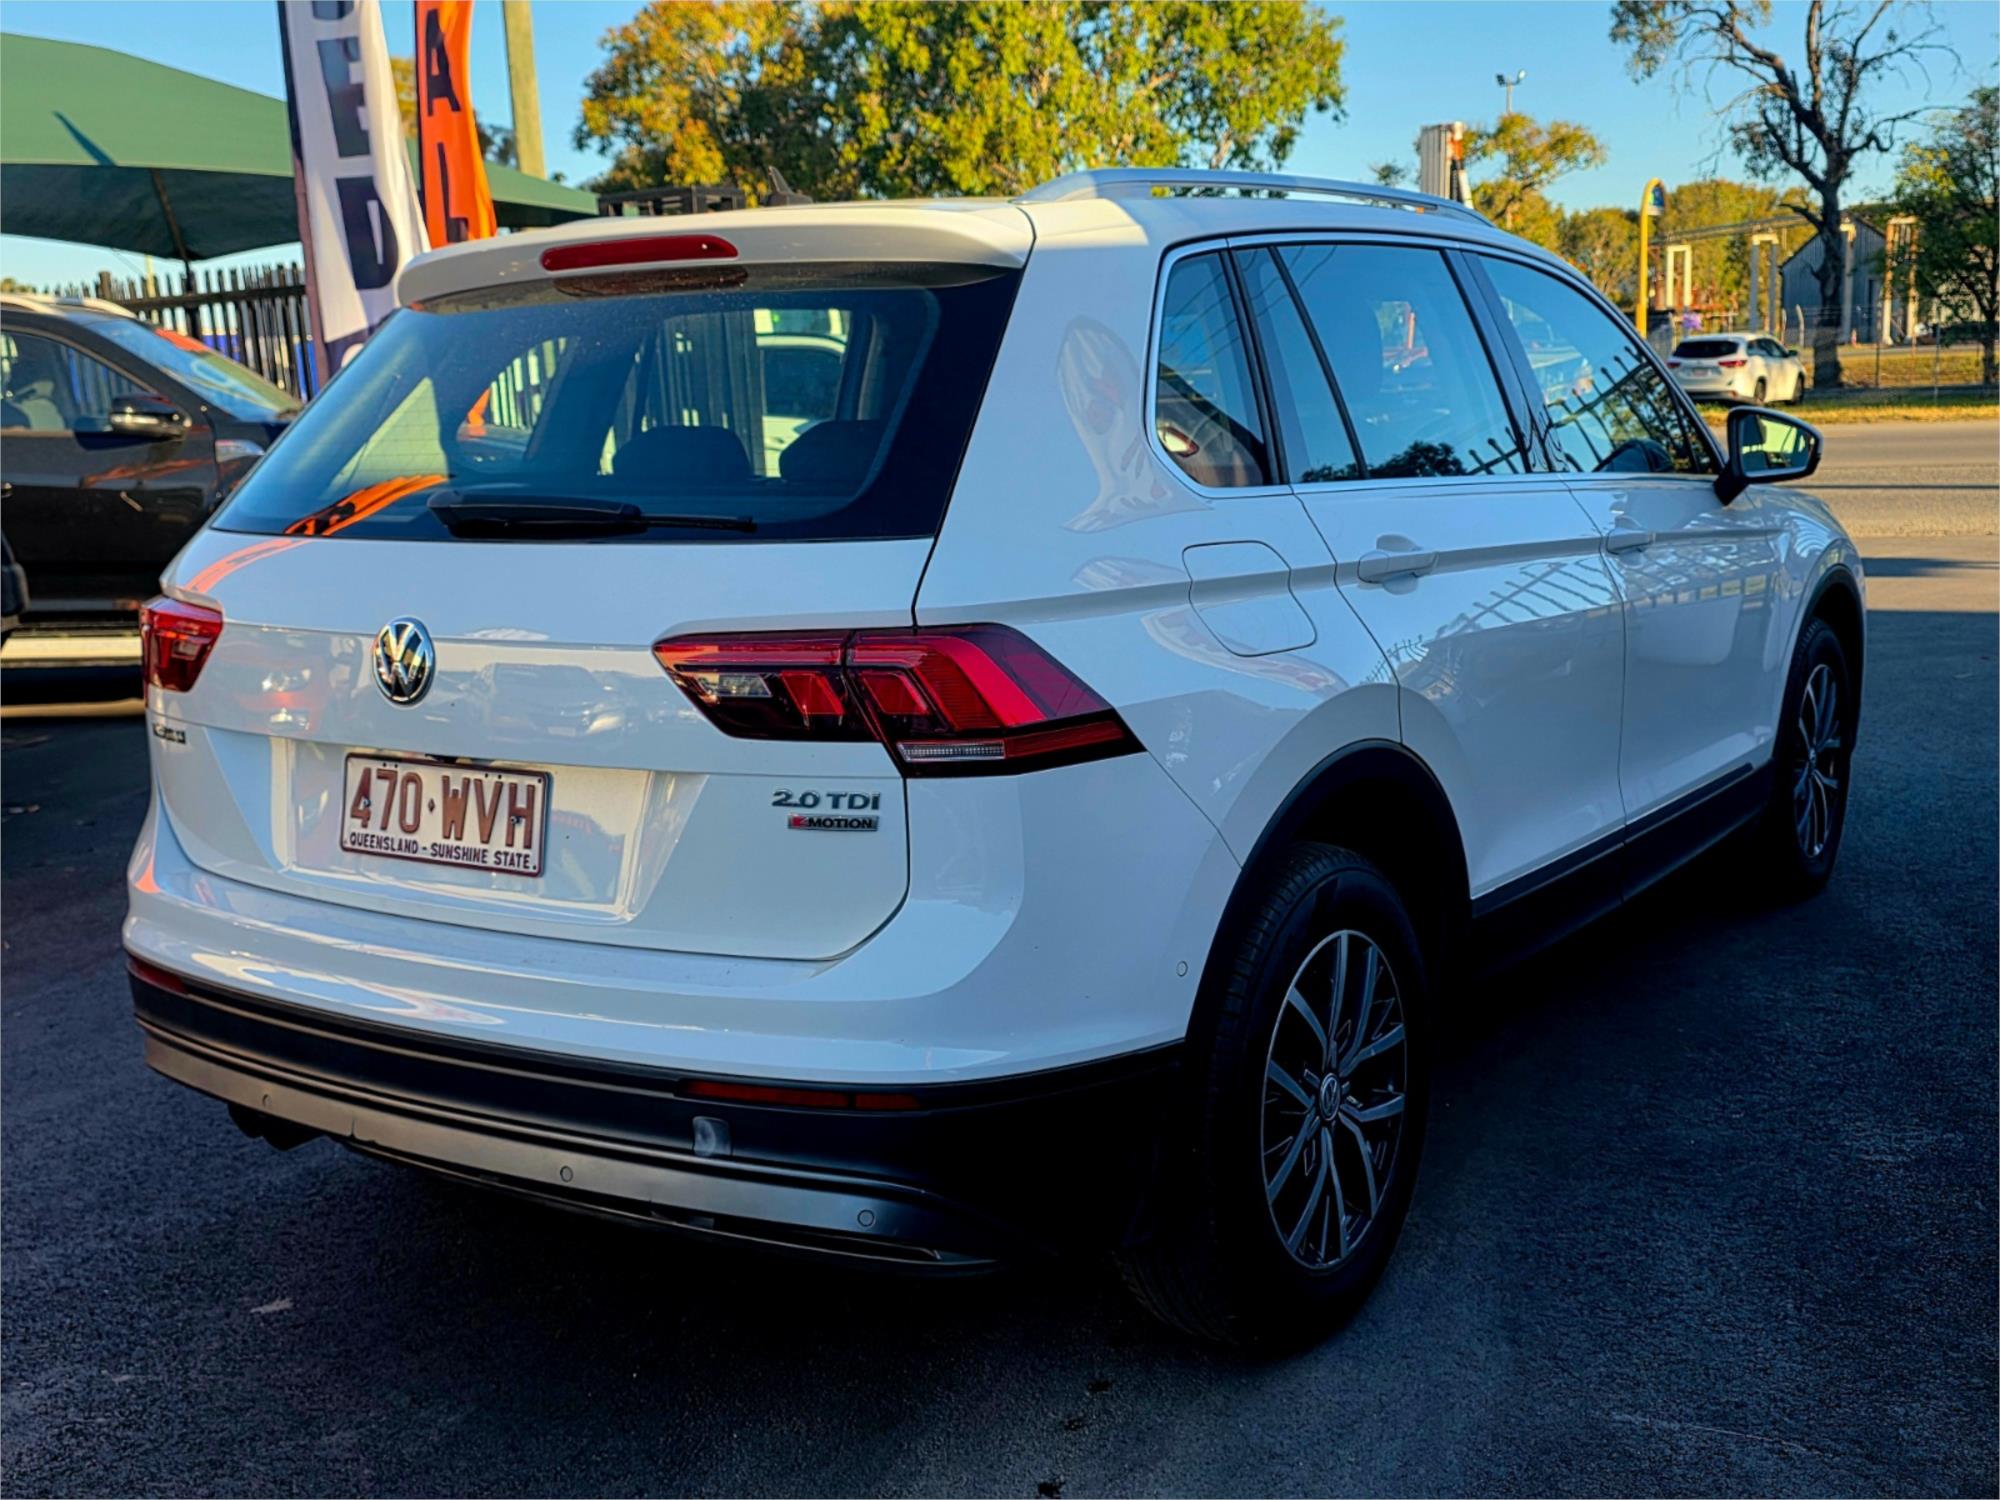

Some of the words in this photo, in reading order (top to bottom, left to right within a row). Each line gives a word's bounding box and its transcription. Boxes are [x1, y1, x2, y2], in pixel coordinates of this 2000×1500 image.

[312, 0, 398, 290] ED
[772, 788, 821, 809] 2.0
[826, 792, 881, 810] TDI
[350, 832, 419, 855] QUEENSLAND
[430, 842, 489, 864] SUNSHINE
